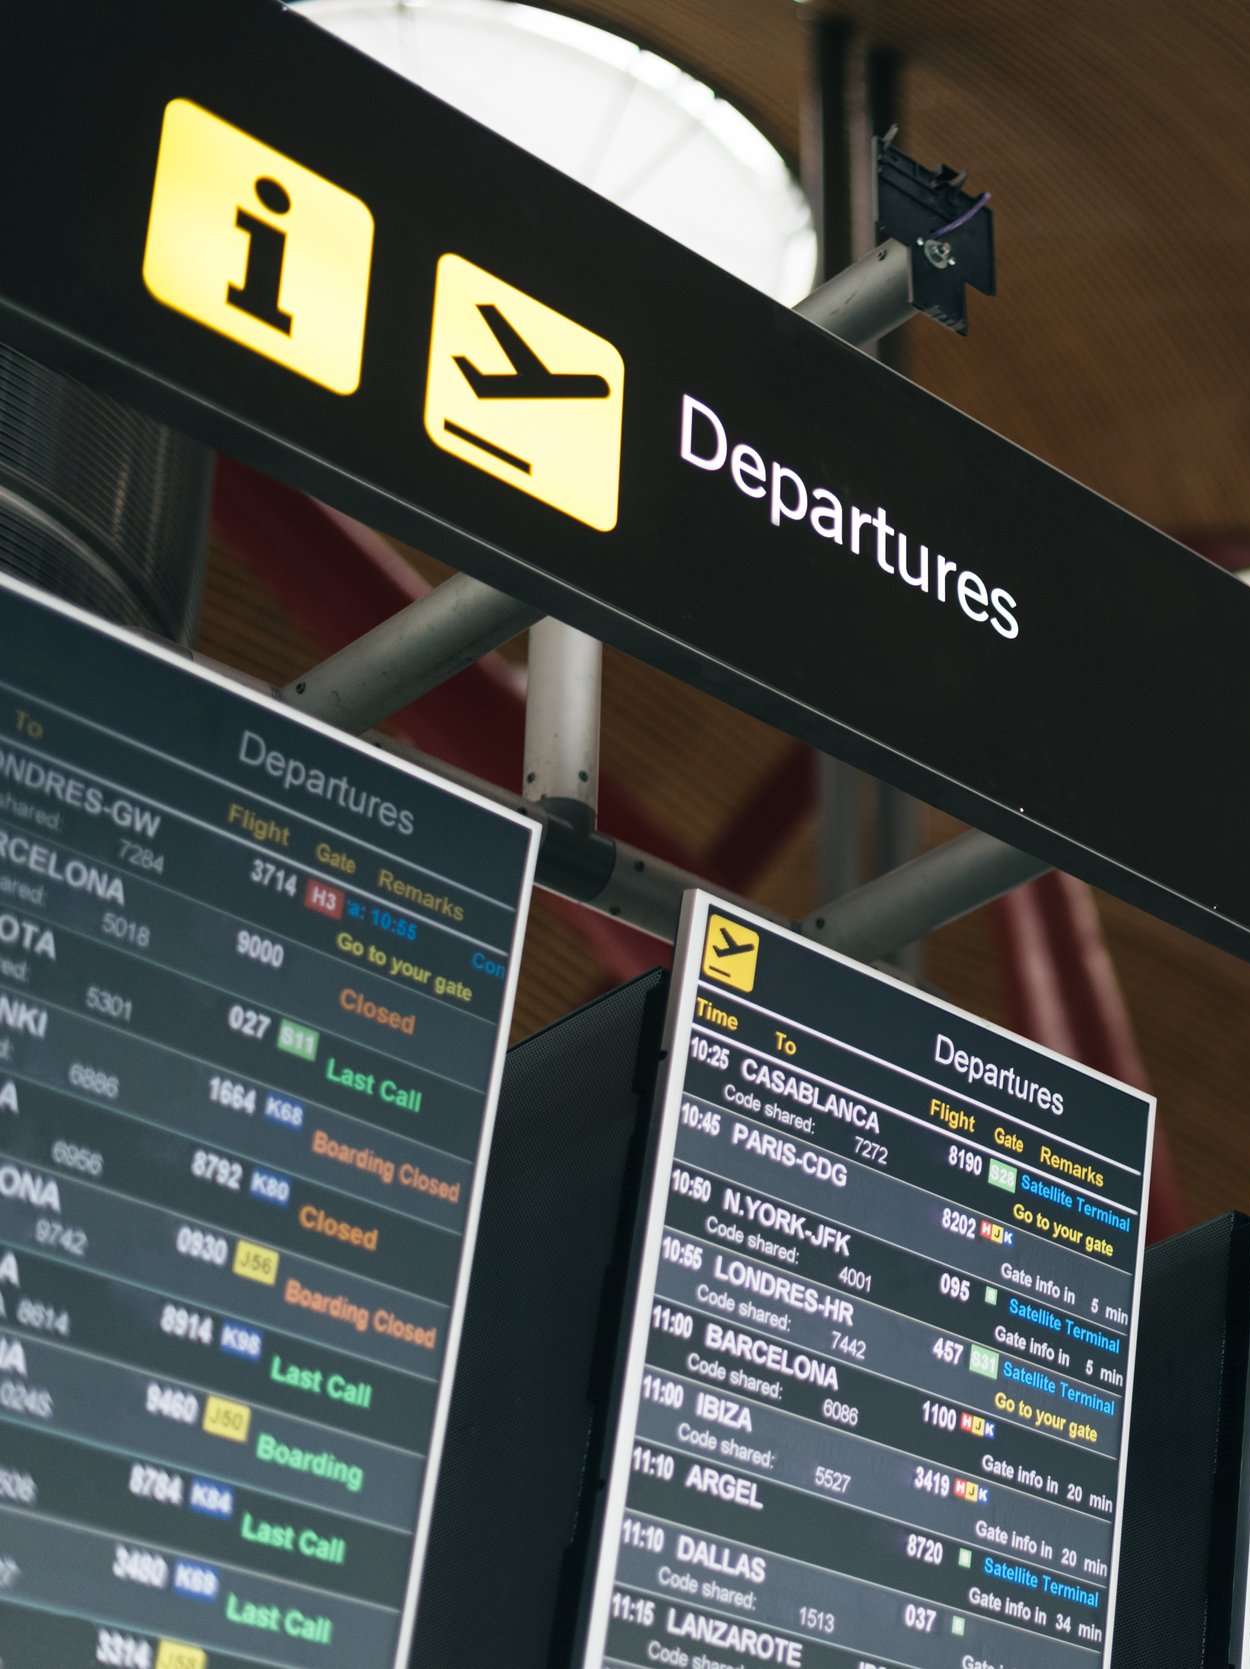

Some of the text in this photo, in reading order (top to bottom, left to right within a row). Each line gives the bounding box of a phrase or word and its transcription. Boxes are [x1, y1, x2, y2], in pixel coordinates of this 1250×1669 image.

[680, 394, 1019, 640] Departures
[239, 730, 415, 835] Departures
[227, 803, 290, 846] Flight
[316, 843, 356, 874] Gate
[378, 869, 465, 921] Remarks
[336, 932, 473, 1000] Go to your gate
[228, 1006, 271, 1039] 027
[339, 988, 416, 1035] Closed
[326, 1057, 422, 1112] Last Call
[696, 997, 1104, 1187] Time To Flight Gate Remarks
[934, 1033, 1065, 1116] Departures
[312, 1130, 461, 1203] Boarding Closed
[682, 1102, 976, 1240] 10:45 PARIS-CDG 8202
[691, 1036, 1131, 1232] 10:25 CASABLANCA 8190 S28 Satellite Terminal
[724, 1084, 1114, 1257] Code shared: 7272 Go to your gate
[299, 1205, 378, 1250] Closed
[672, 1169, 1120, 1354] 10:50 N.YORK-JFK 095 Satellite Terminal
[285, 1278, 437, 1349] Boarding Closed
[662, 1236, 1115, 1416] 10:55 LONDRES-HR 457 Satellite Terminal
[706, 1216, 1123, 1387] Code shared: 4001 Gate info in 5 min
[1001, 1262, 1128, 1326] Gate info in 5 min
[271, 1355, 372, 1407] Last Call
[653, 1305, 957, 1431] 11:00 BARCELONA 1100
[696, 1284, 1098, 1443] Code shared: 7442 Go to your gate
[256, 1432, 364, 1492] Boarding
[642, 1375, 950, 1497] 11:00 IBIZA 3419
[687, 1353, 1113, 1513] Code shared: 6086 Gate info in 20 min
[241, 1512, 345, 1564] Last Call
[633, 1446, 674, 1481] 11:10
[684, 1465, 764, 1510] ARGEL
[907, 1534, 943, 1565] 8720
[983, 1556, 1038, 1589] Satellite
[1042, 1575, 1098, 1608] Terminal
[678, 1423, 1108, 1578] Code shared: 5527 Gate info in 20 min
[623, 1518, 766, 1583] 11:10 DALLAS
[226, 1592, 333, 1644] Last Call
[612, 1592, 802, 1667] 11:15 LANZAROTE
[658, 1566, 835, 1634] Code shared: 1513
[969, 1586, 1102, 1643] Gate info in 34 min
